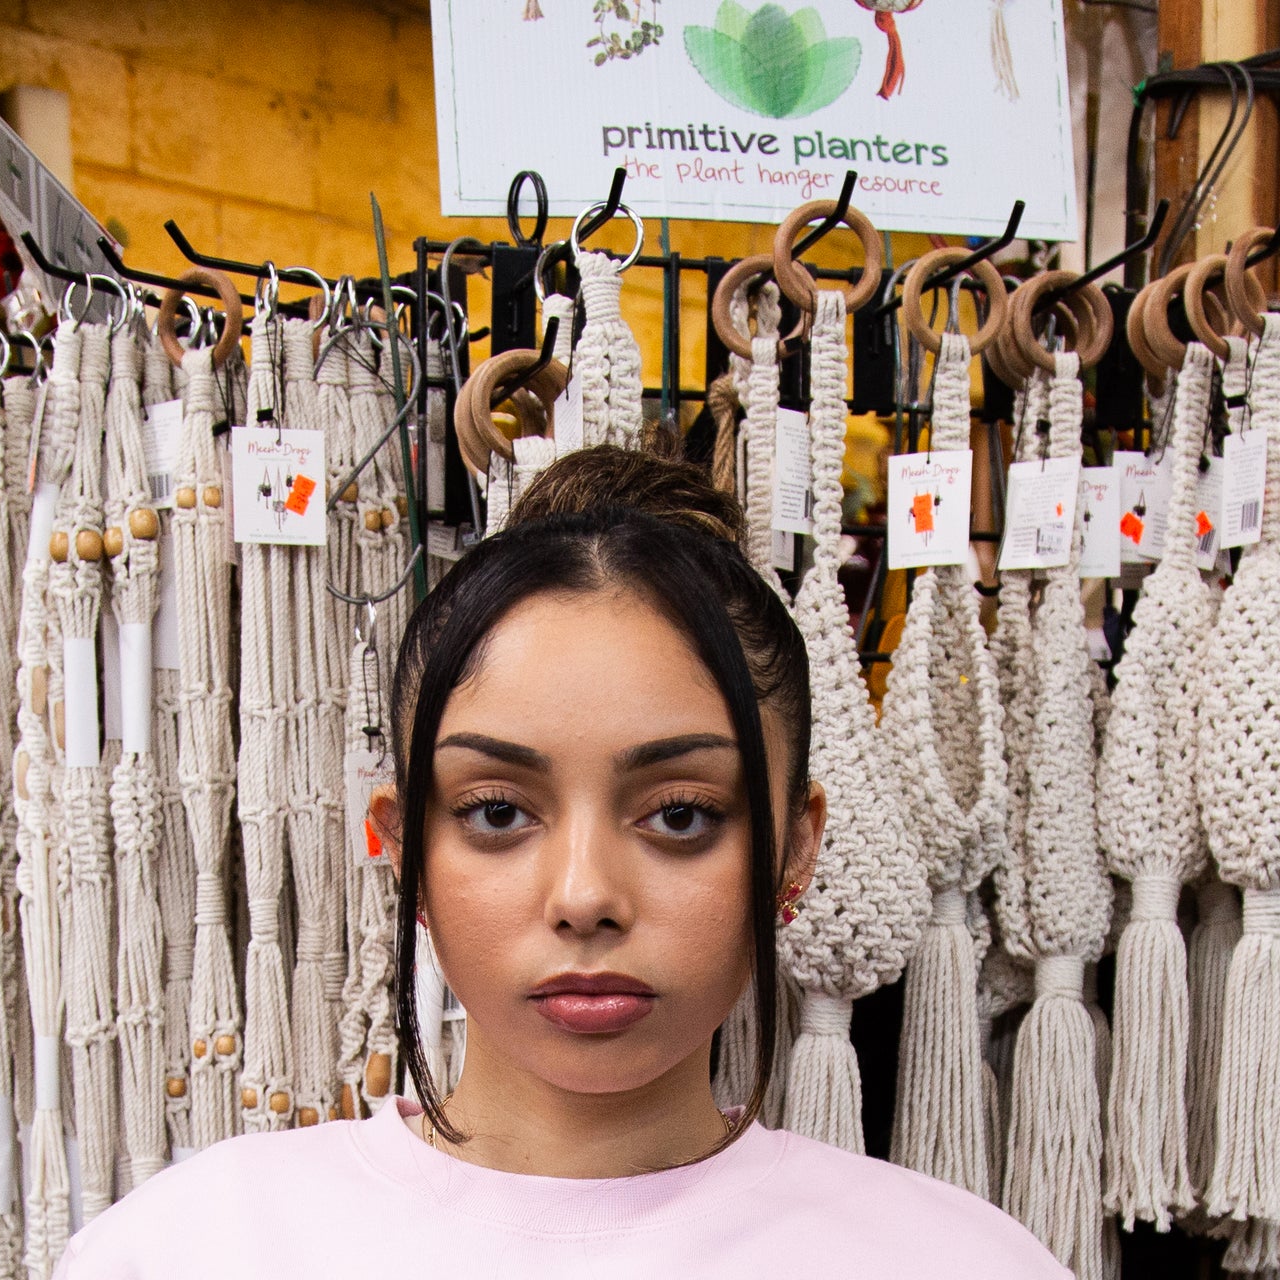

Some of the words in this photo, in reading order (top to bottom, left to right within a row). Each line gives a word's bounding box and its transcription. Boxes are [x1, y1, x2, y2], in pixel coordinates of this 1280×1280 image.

[602, 122, 780, 156] primitive
[793, 130, 949, 166] planters
[620, 154, 662, 180] the
[676, 156, 744, 184] plant
[757, 163, 835, 200] hanger
[847, 174, 943, 197] esource
